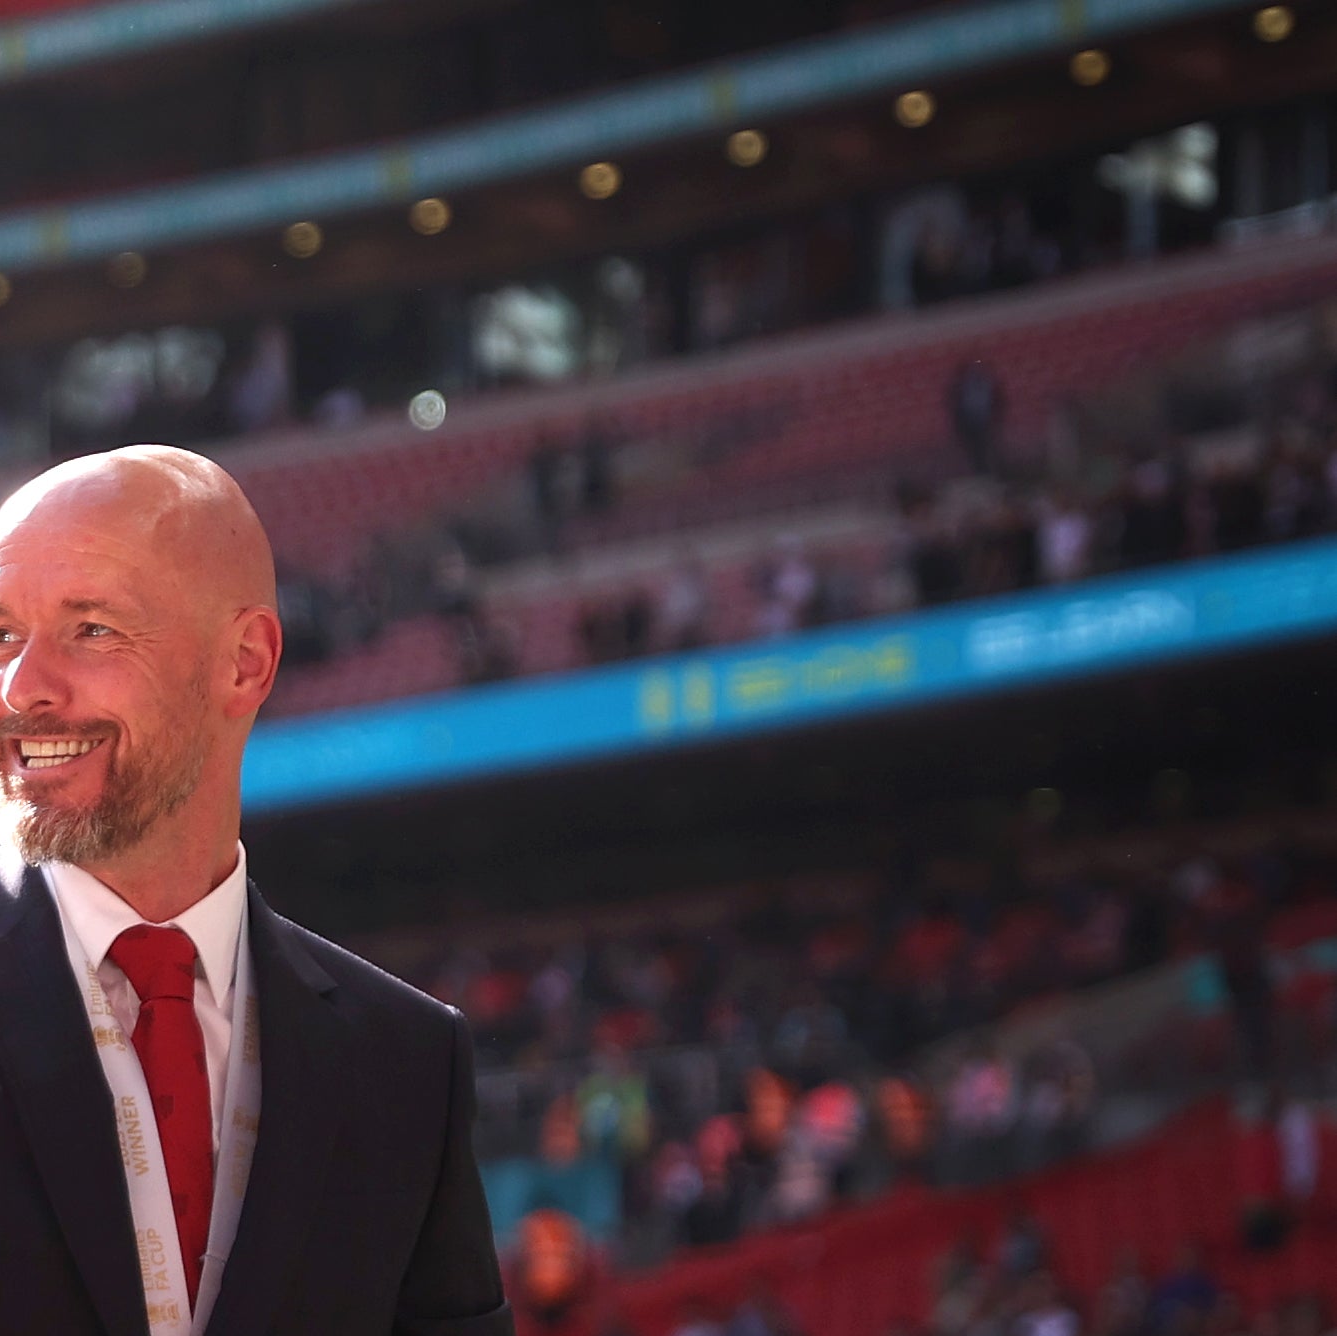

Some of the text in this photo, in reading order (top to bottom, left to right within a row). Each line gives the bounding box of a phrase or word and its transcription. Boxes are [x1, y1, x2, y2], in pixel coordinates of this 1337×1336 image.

[121, 1095, 150, 1177] WINNER
[146, 1227, 171, 1291] FA CUP
